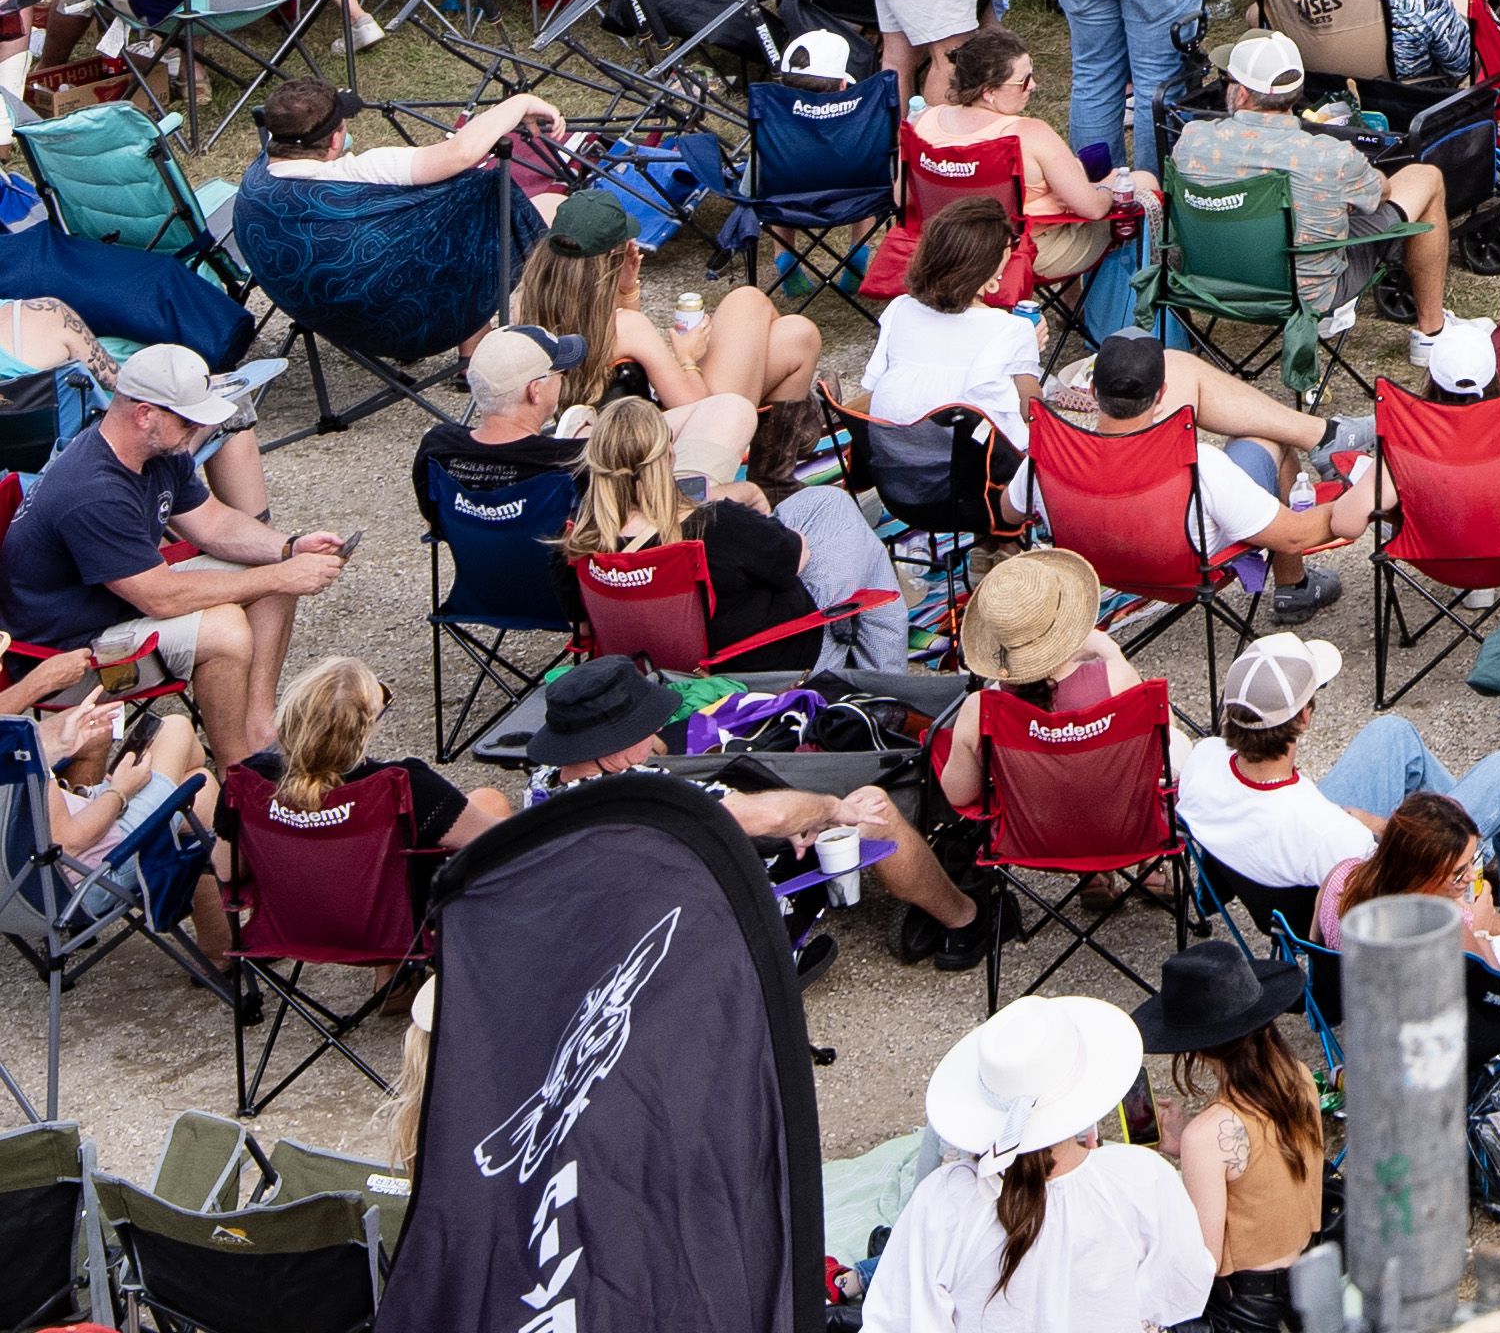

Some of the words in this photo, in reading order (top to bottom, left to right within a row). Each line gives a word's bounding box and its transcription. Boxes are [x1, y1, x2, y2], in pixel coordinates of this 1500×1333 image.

[756, 23, 781, 66] ROCKER
[793, 96, 862, 116] Academy
[921, 152, 988, 178] Academy
[1184, 188, 1248, 210] Academy
[455, 492, 527, 519] Academy
[589, 558, 657, 586] Academy
[1029, 714, 1113, 740] Academy
[269, 799, 355, 824] Academy
